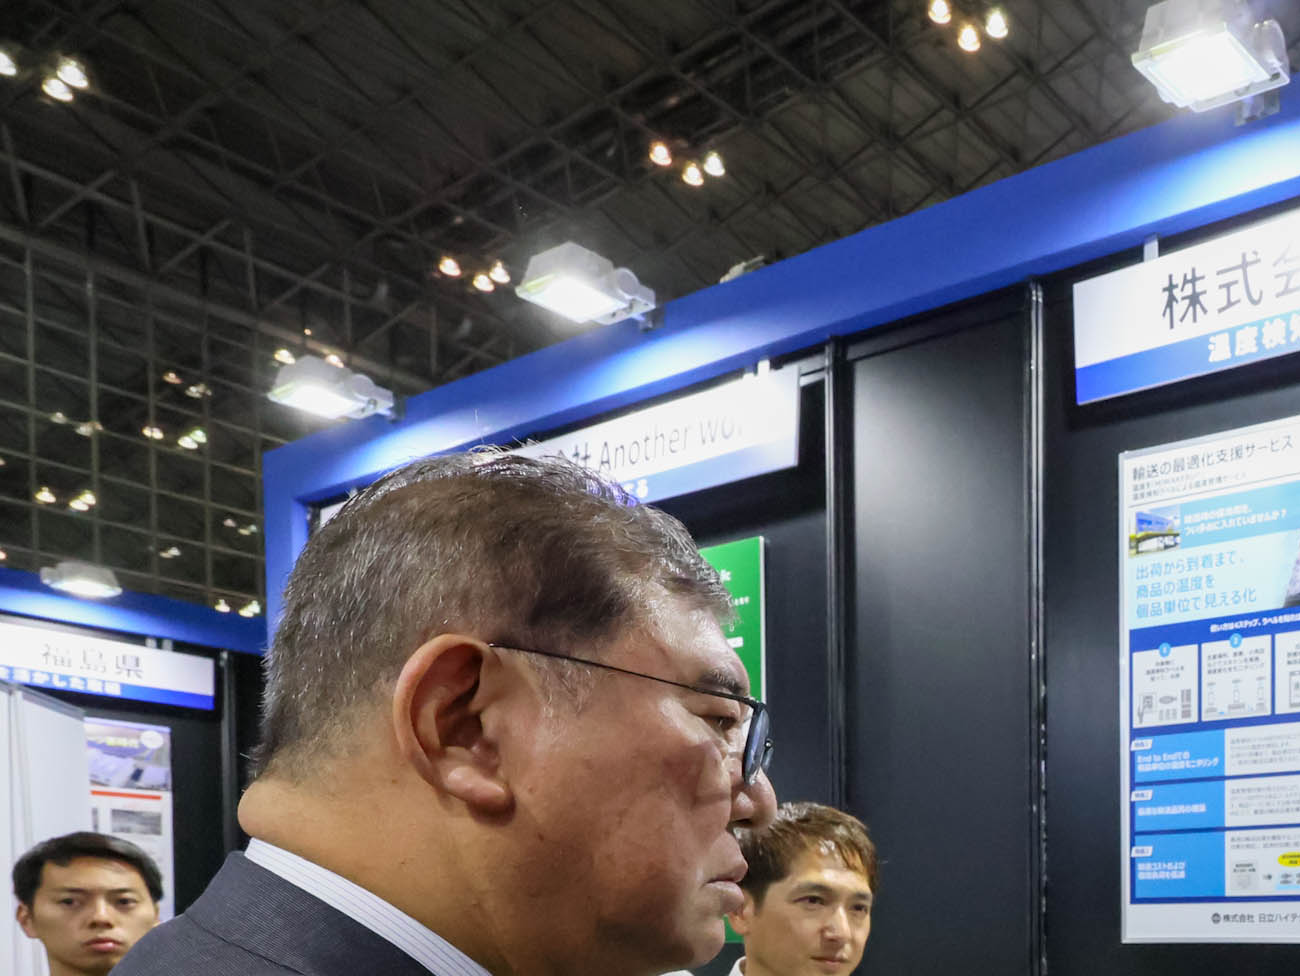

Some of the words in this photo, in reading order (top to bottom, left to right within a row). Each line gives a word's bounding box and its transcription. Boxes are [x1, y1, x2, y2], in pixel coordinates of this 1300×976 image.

[599, 424, 690, 472] Another
[1132, 434, 1294, 482] 輸送の最適化支援サービス
